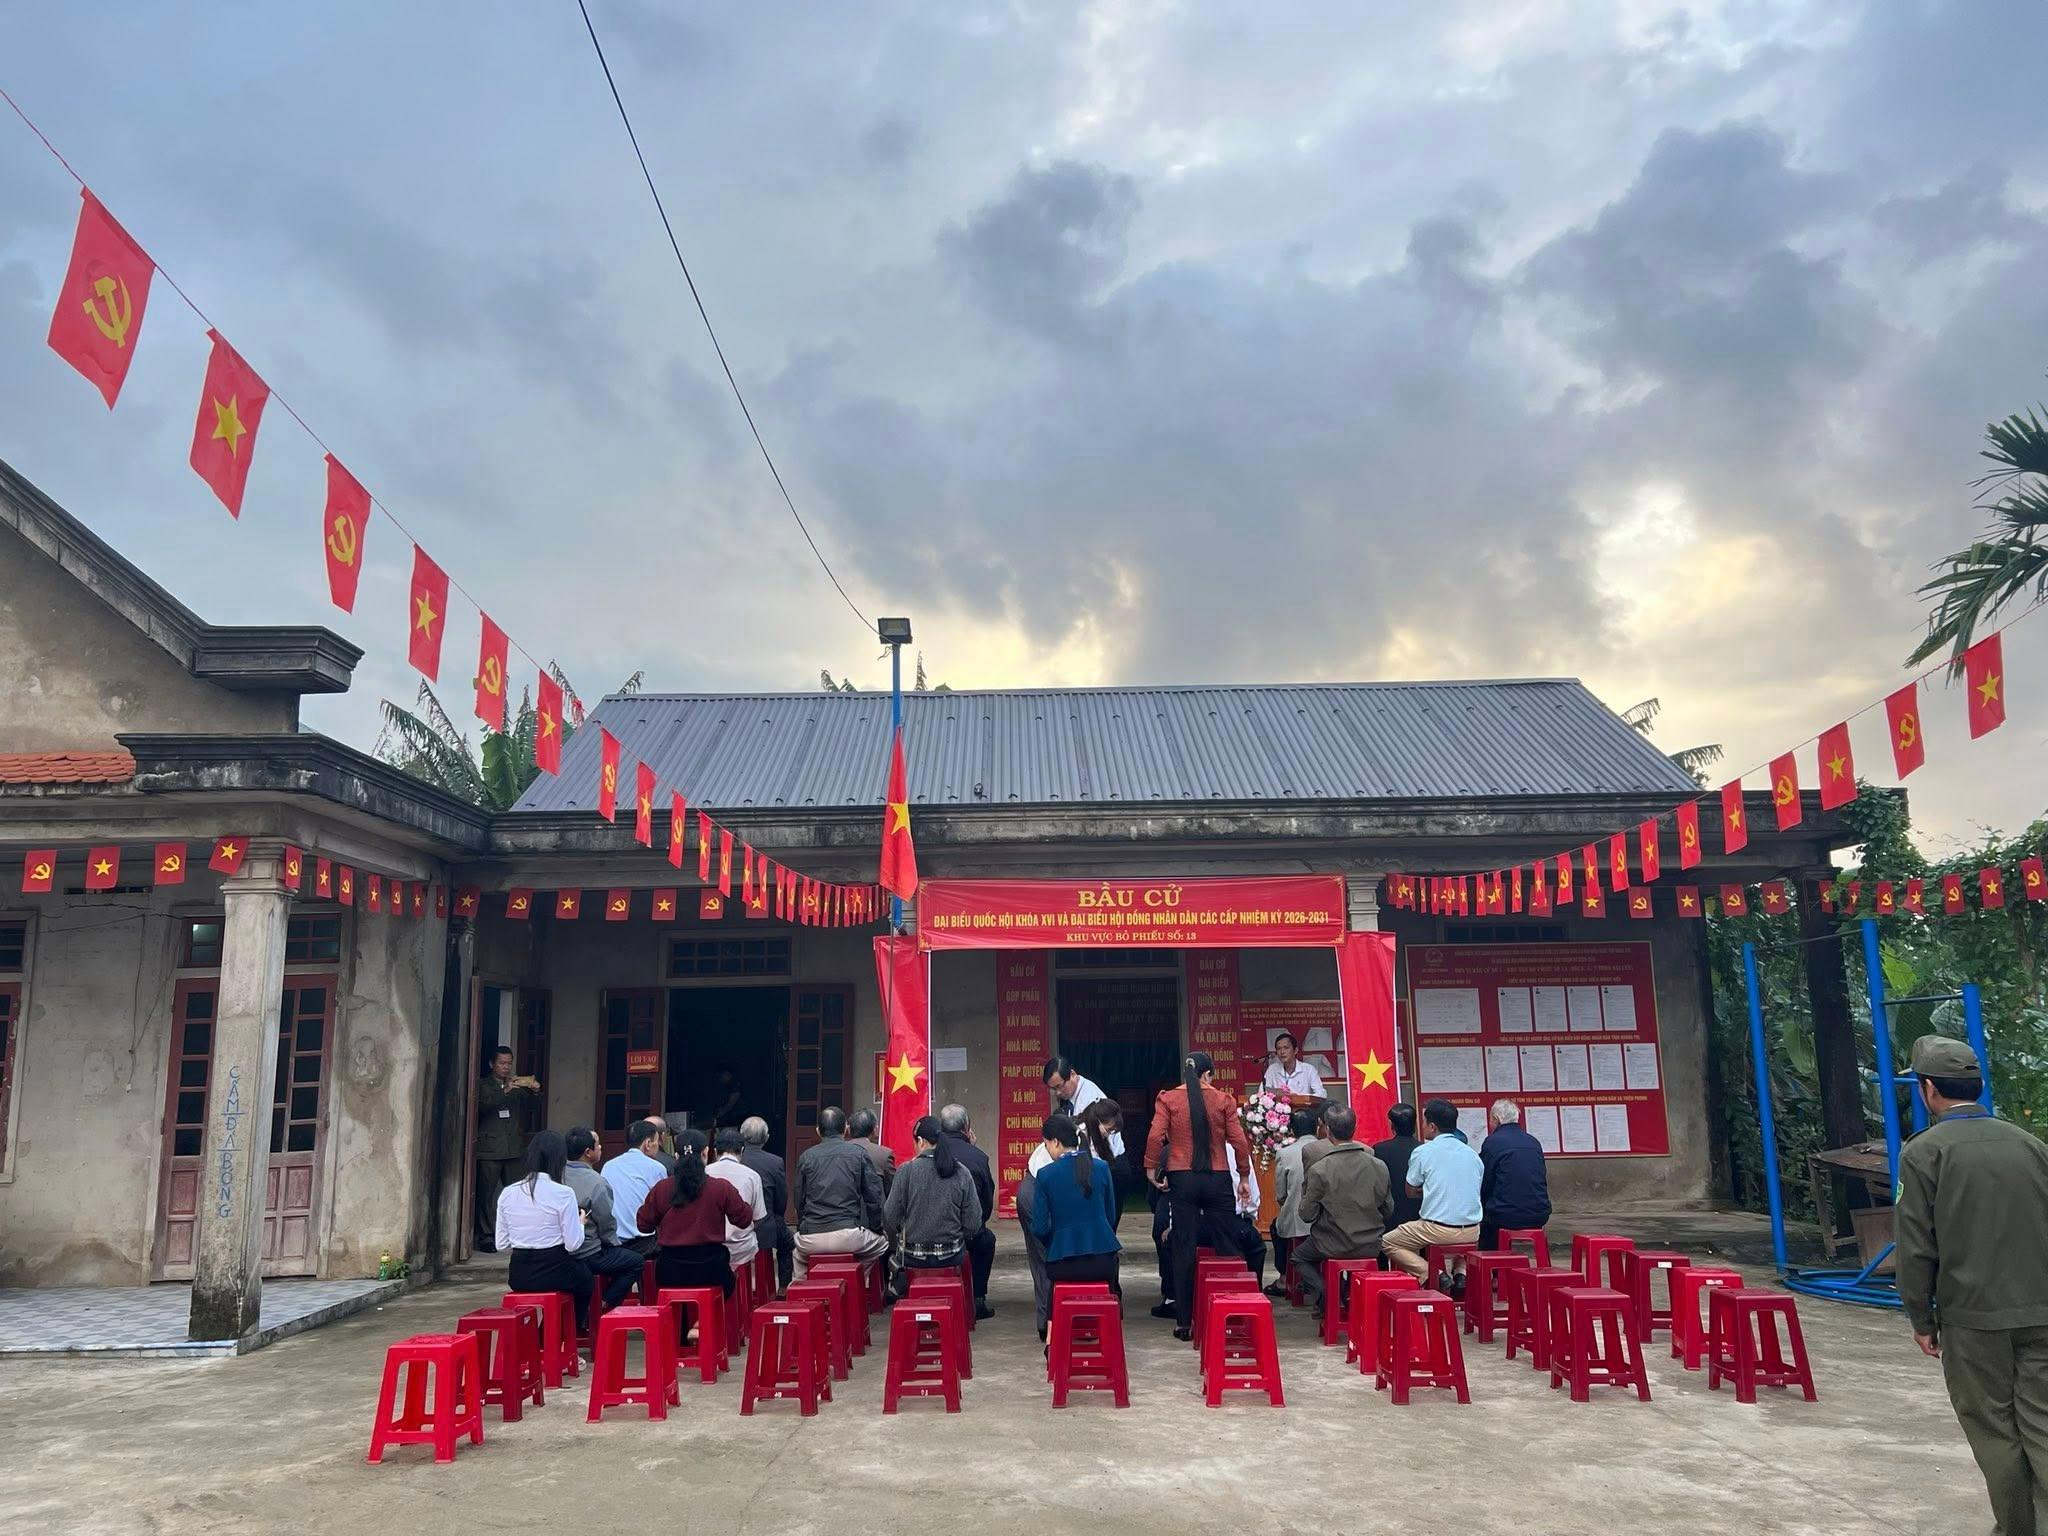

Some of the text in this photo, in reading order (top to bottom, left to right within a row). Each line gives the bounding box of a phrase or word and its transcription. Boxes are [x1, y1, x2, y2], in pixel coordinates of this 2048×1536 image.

[1078, 881, 1183, 907] BẦU CỬ
[934, 907, 1329, 930] ĐẠI BIỂU QUỐC HỘI KHÓA XVI VÀ ĐẠI BIỂU HỘI ĐỒNG NHÂN DÂN CÁC CẤP NHIỆM KỲ 2026-2031
[1066, 933, 1089, 942] KHU
[1091, 932, 1113, 943] VỰC
[1115, 930, 1129, 941] BỎ
[1132, 931, 1165, 941] PHIẾU
[1167, 929, 1184, 941] SỐ:
[224, 1117, 237, 1148] ĐÁ
[1006, 1113, 1020, 1129] CHỦ
[219, 1153, 233, 1218] BÓNG
